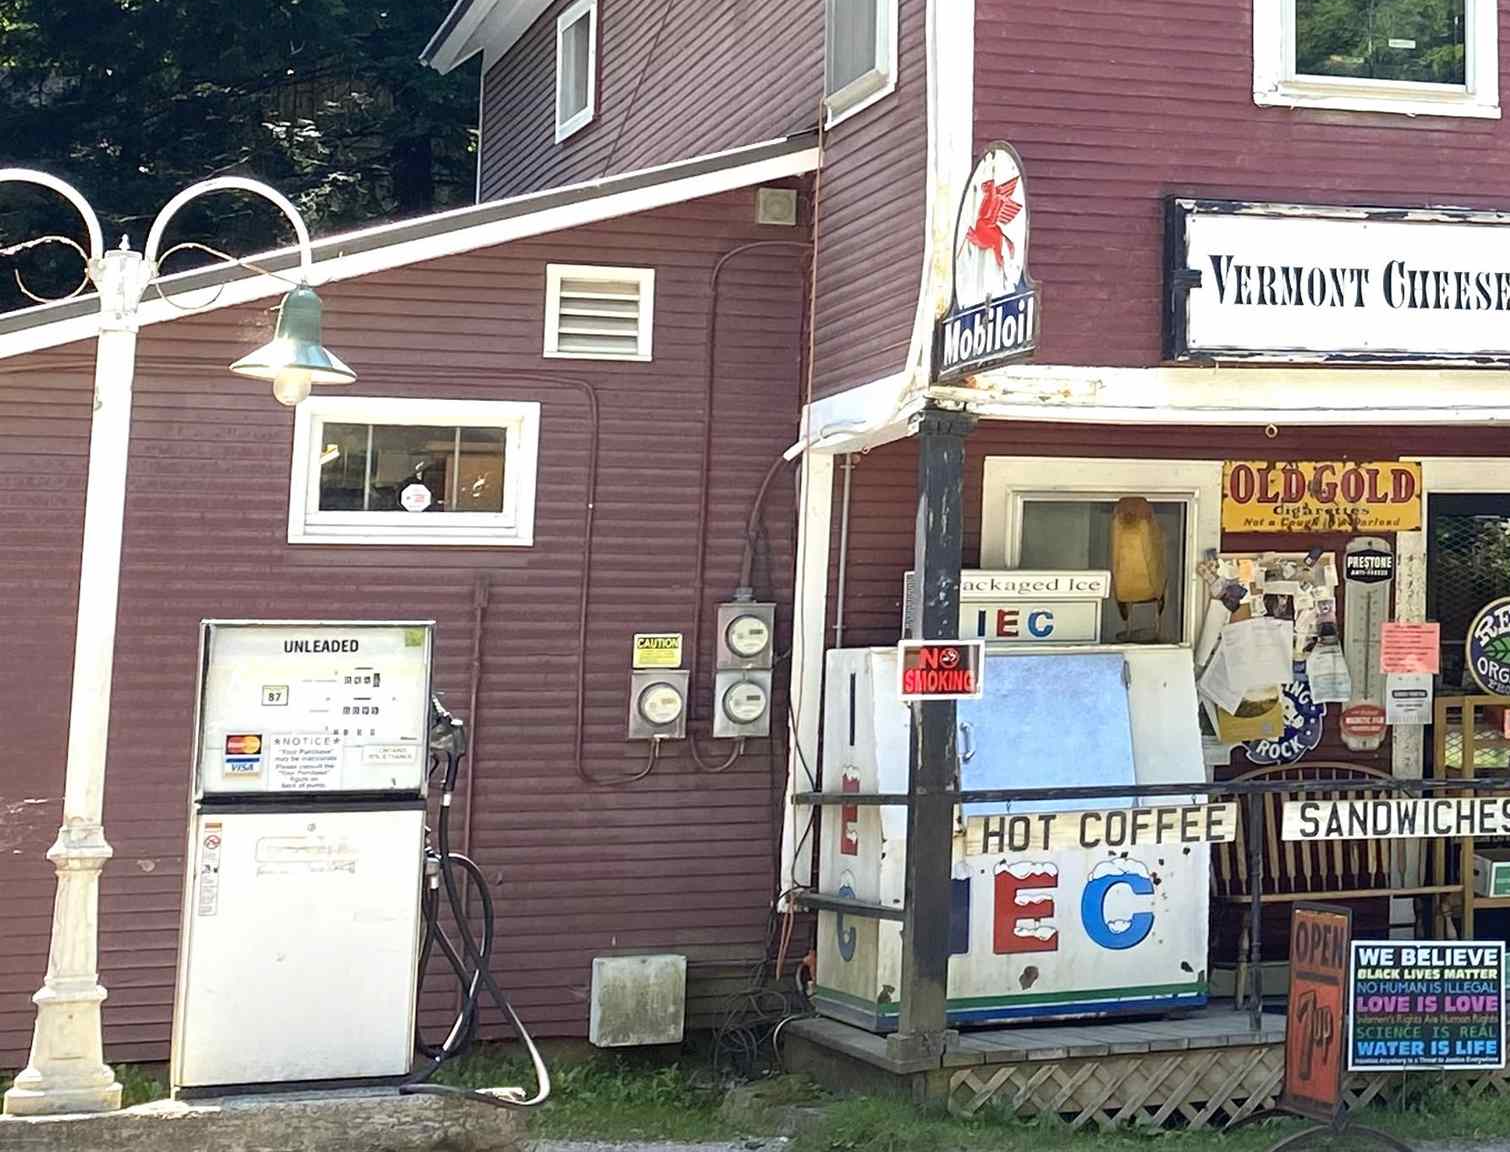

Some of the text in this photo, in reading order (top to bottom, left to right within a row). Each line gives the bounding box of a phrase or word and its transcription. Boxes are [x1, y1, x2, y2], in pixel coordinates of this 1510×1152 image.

[1209, 255, 1369, 307] VERMONT
[944, 297, 1034, 367] Mobiloil
[1230, 464, 1416, 504] OLD GOLD
[1347, 556, 1392, 569] PRESTONE
[962, 578, 1101, 595] ackaged Ice
[284, 640, 359, 653] UNLEADED
[637, 638, 679, 649] CAUTION
[905, 670, 975, 691] SMOKING
[268, 692, 282, 702] 87
[1255, 735, 1305, 758] ROCK
[231, 763, 254, 772] VISA
[982, 805, 1227, 854] HOT COFFEE
[1296, 920, 1346, 970] OPEN
[1359, 948, 1498, 966] WE BELIEVE
[1357, 968, 1498, 980] BLACK LIVES MATTER
[1357, 981, 1497, 994] NO HUMAN IS ILLEGAL
[1357, 996, 1498, 1013] LOVE IS LOVE
[1357, 1026, 1496, 1039] SCIENCE IS REAL
[1357, 1040, 1497, 1056] WATER IS LIFE
